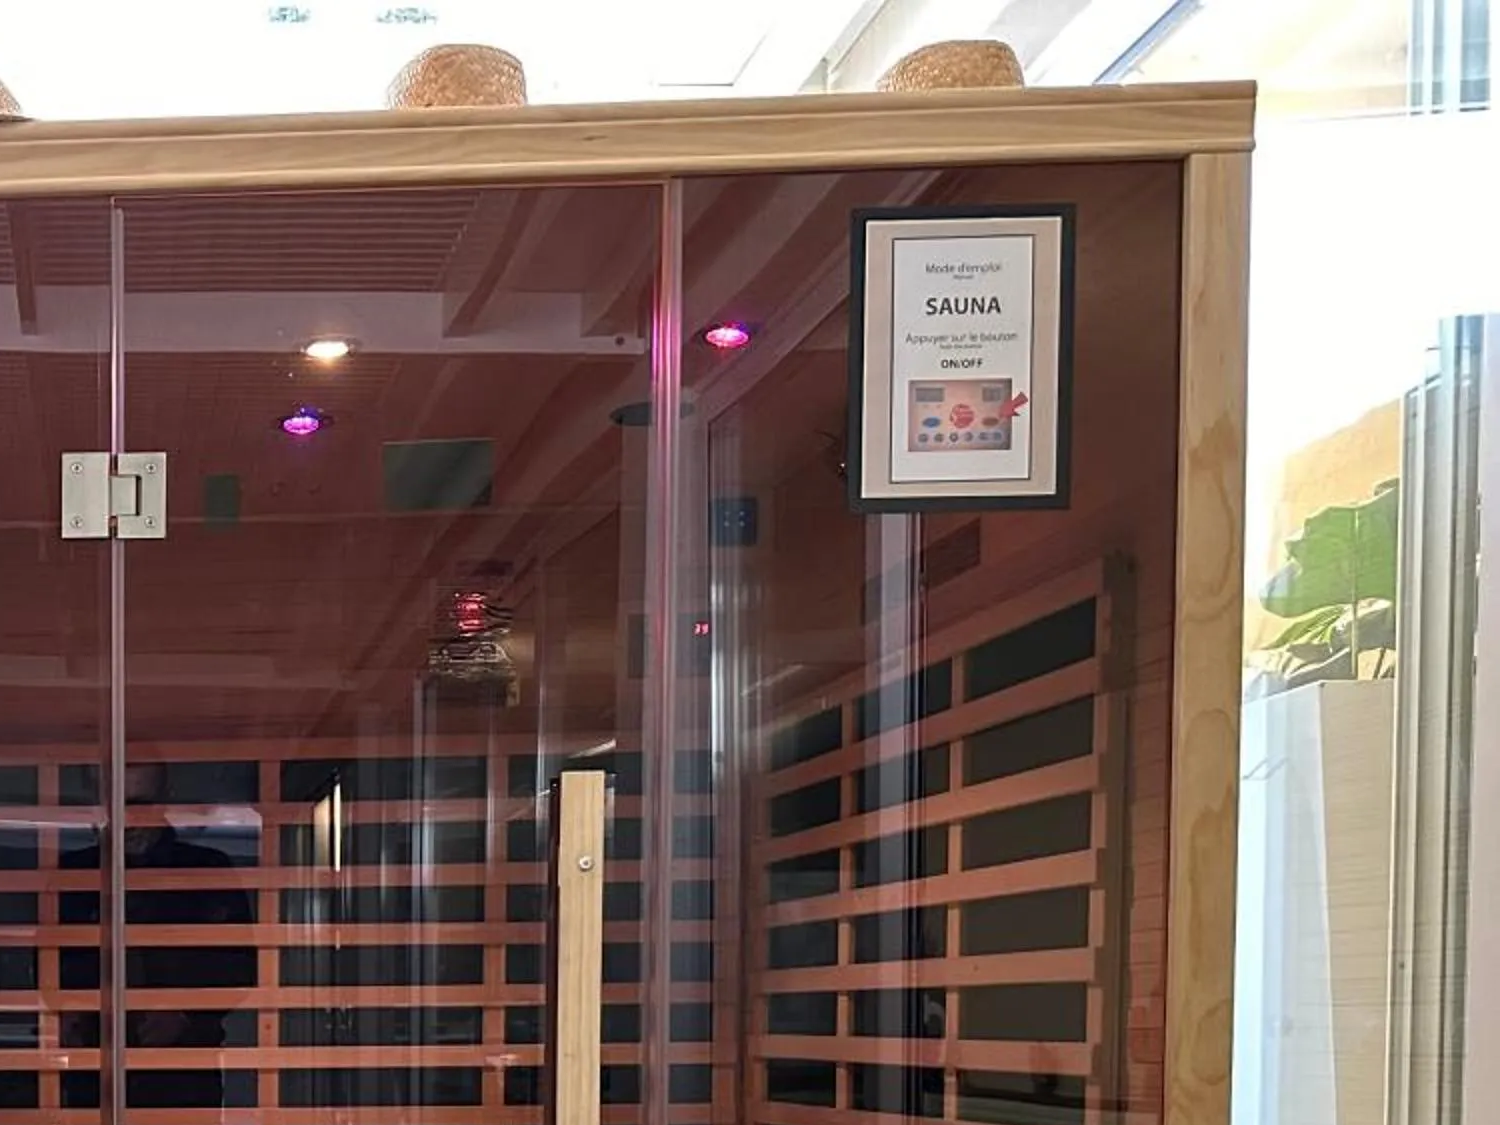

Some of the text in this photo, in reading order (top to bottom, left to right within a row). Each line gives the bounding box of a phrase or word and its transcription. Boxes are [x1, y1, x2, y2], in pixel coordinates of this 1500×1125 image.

[925, 263, 955, 273] Mode
[925, 296, 1002, 315] SAUNA
[905, 333, 948, 345] Appuyer
[950, 334, 967, 343] sur
[980, 331, 1018, 342] bouton
[941, 358, 983, 369] ON/OFF
